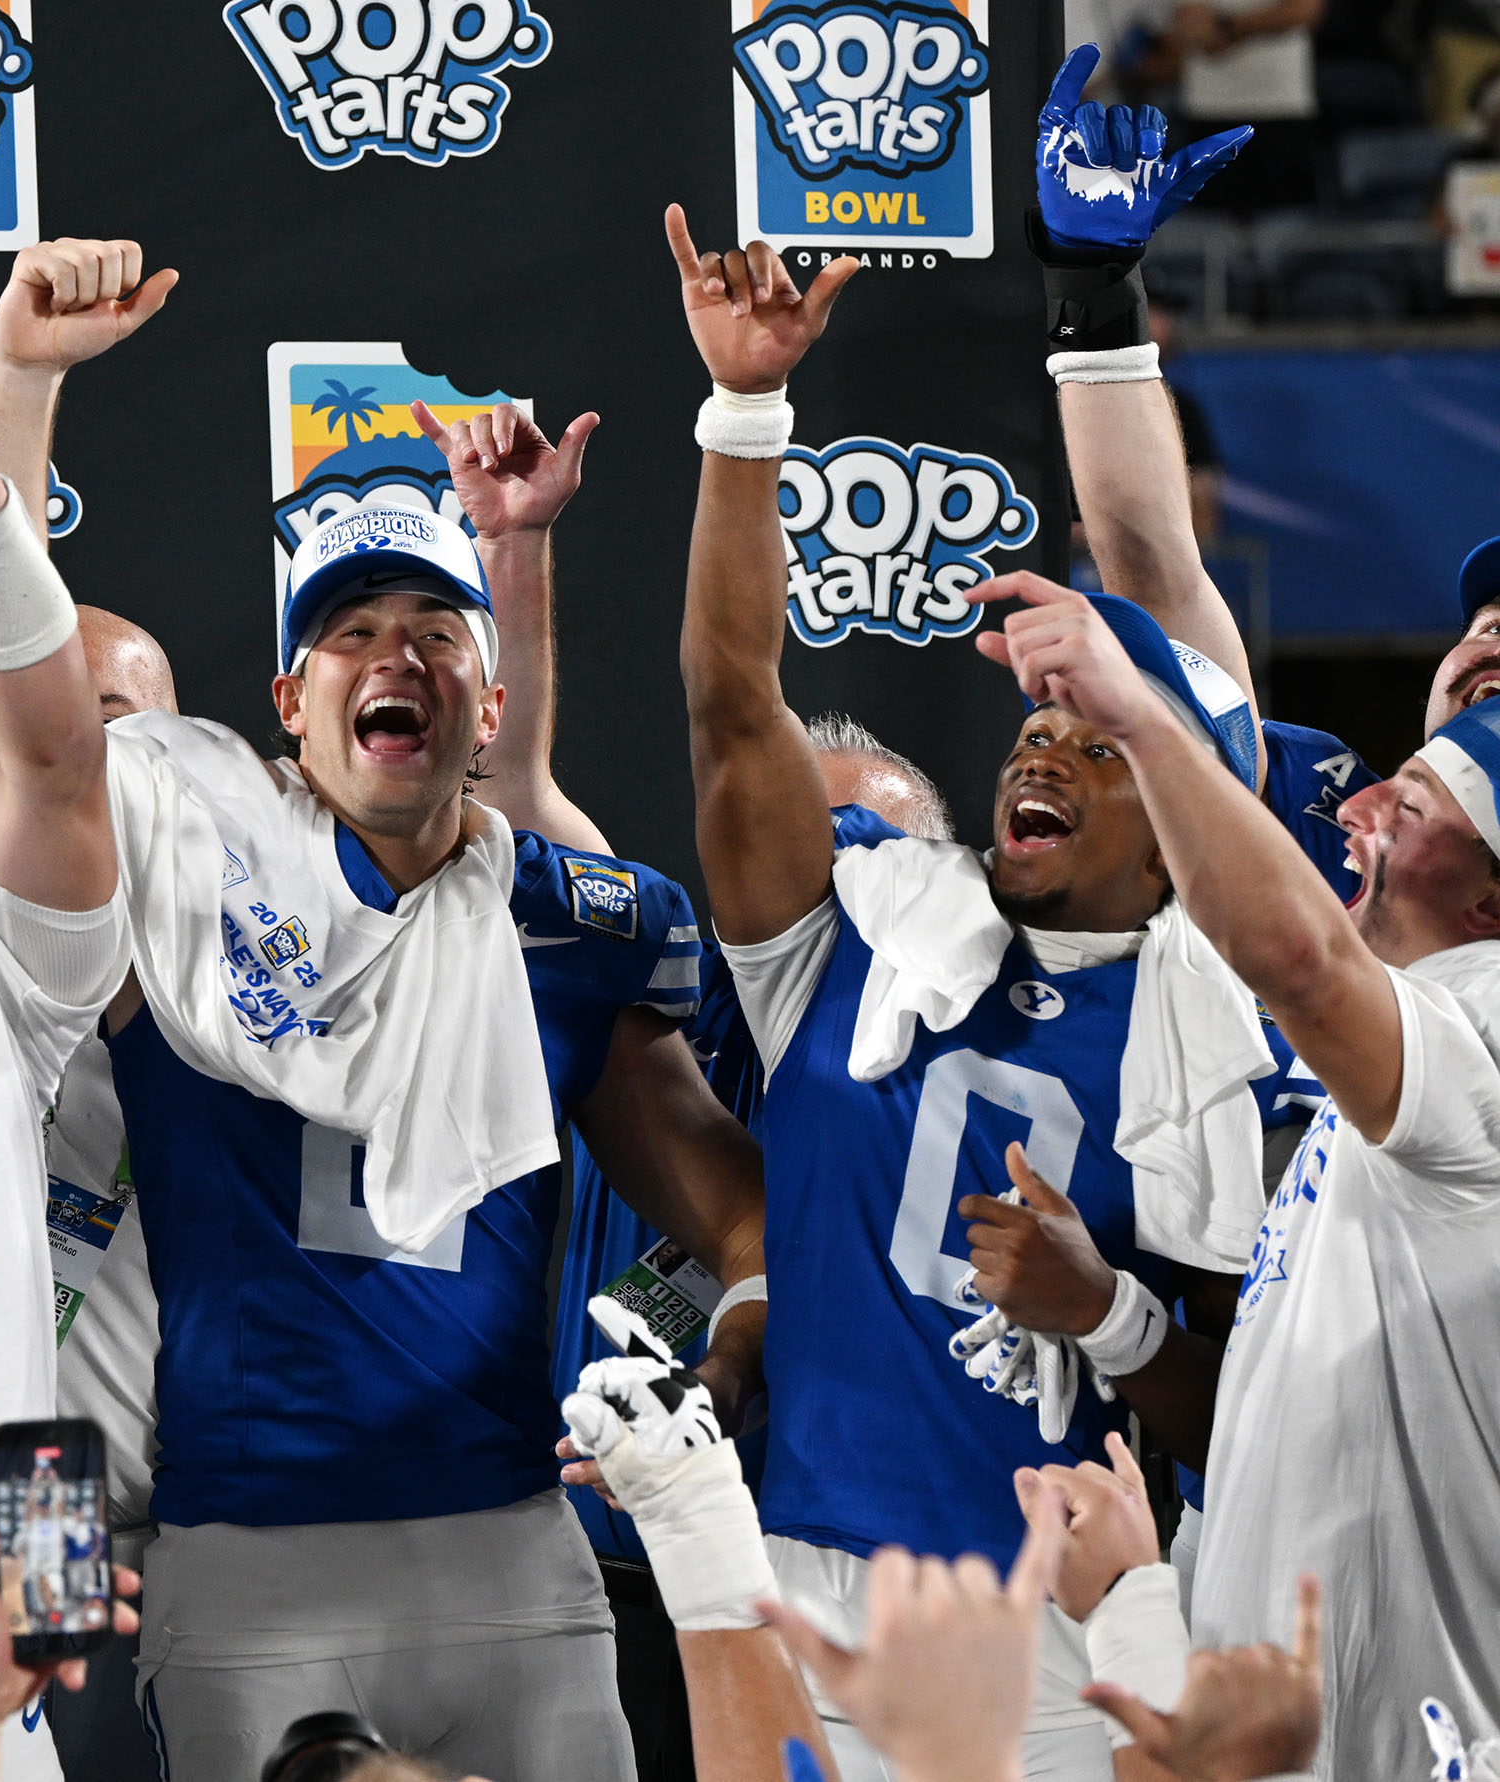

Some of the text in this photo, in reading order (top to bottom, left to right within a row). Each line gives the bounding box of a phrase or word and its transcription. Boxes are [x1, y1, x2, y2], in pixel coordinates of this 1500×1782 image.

[294, 73, 496, 154] tarts
[786, 97, 946, 164] tarts
[805, 191, 926, 225] BOWL
[333, 511, 379, 530] PEOPLE'S
[380, 510, 426, 522] NATIONAL
[315, 516, 437, 562] CHAMPIONS
[787, 553, 980, 632] tarts
[248, 901, 279, 926] 20
[586, 894, 626, 912] tarts
[292, 960, 323, 988] 25
[48, 1230, 69, 1244] BRIAN
[48, 1239, 77, 1257] ANTIAGO
[690, 1263, 710, 1280] REESE
[57, 1290, 70, 1306] 3
[654, 1286, 699, 1324] 1 2 3
[655, 1310, 670, 1323] 4
[670, 1323, 686, 1336] 5
